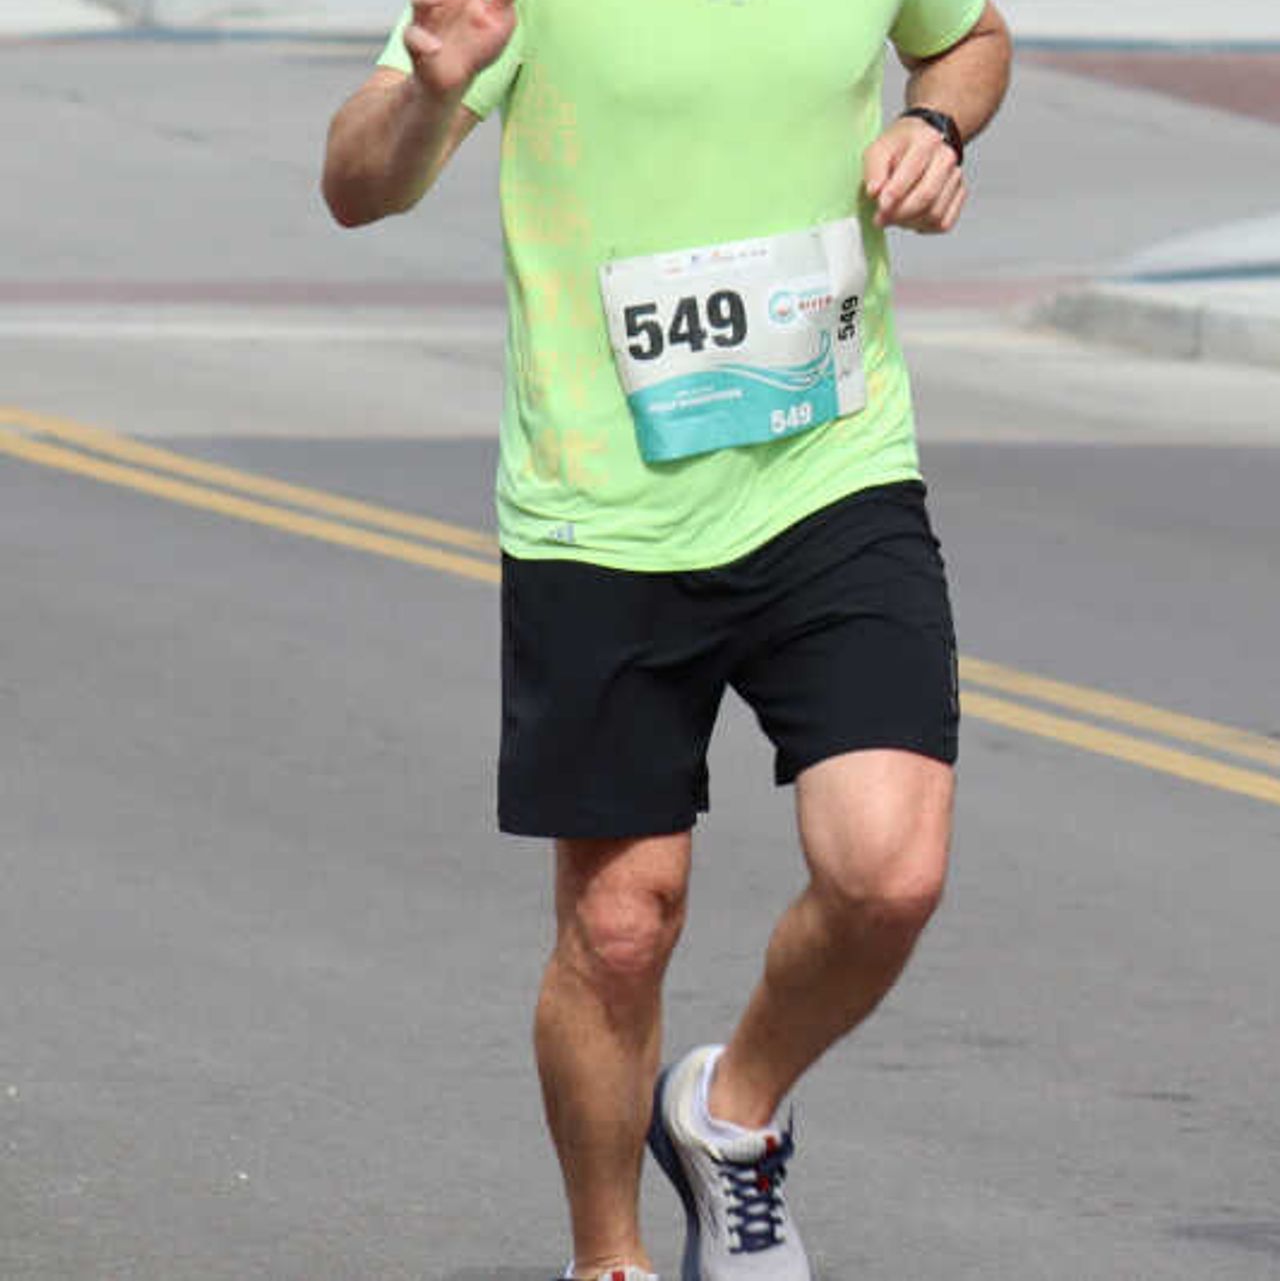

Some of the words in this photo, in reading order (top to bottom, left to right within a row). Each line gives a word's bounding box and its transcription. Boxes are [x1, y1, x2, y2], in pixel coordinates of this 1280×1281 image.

[623, 289, 748, 361] 549
[837, 294, 859, 342] 549
[769, 402, 813, 433] 549
